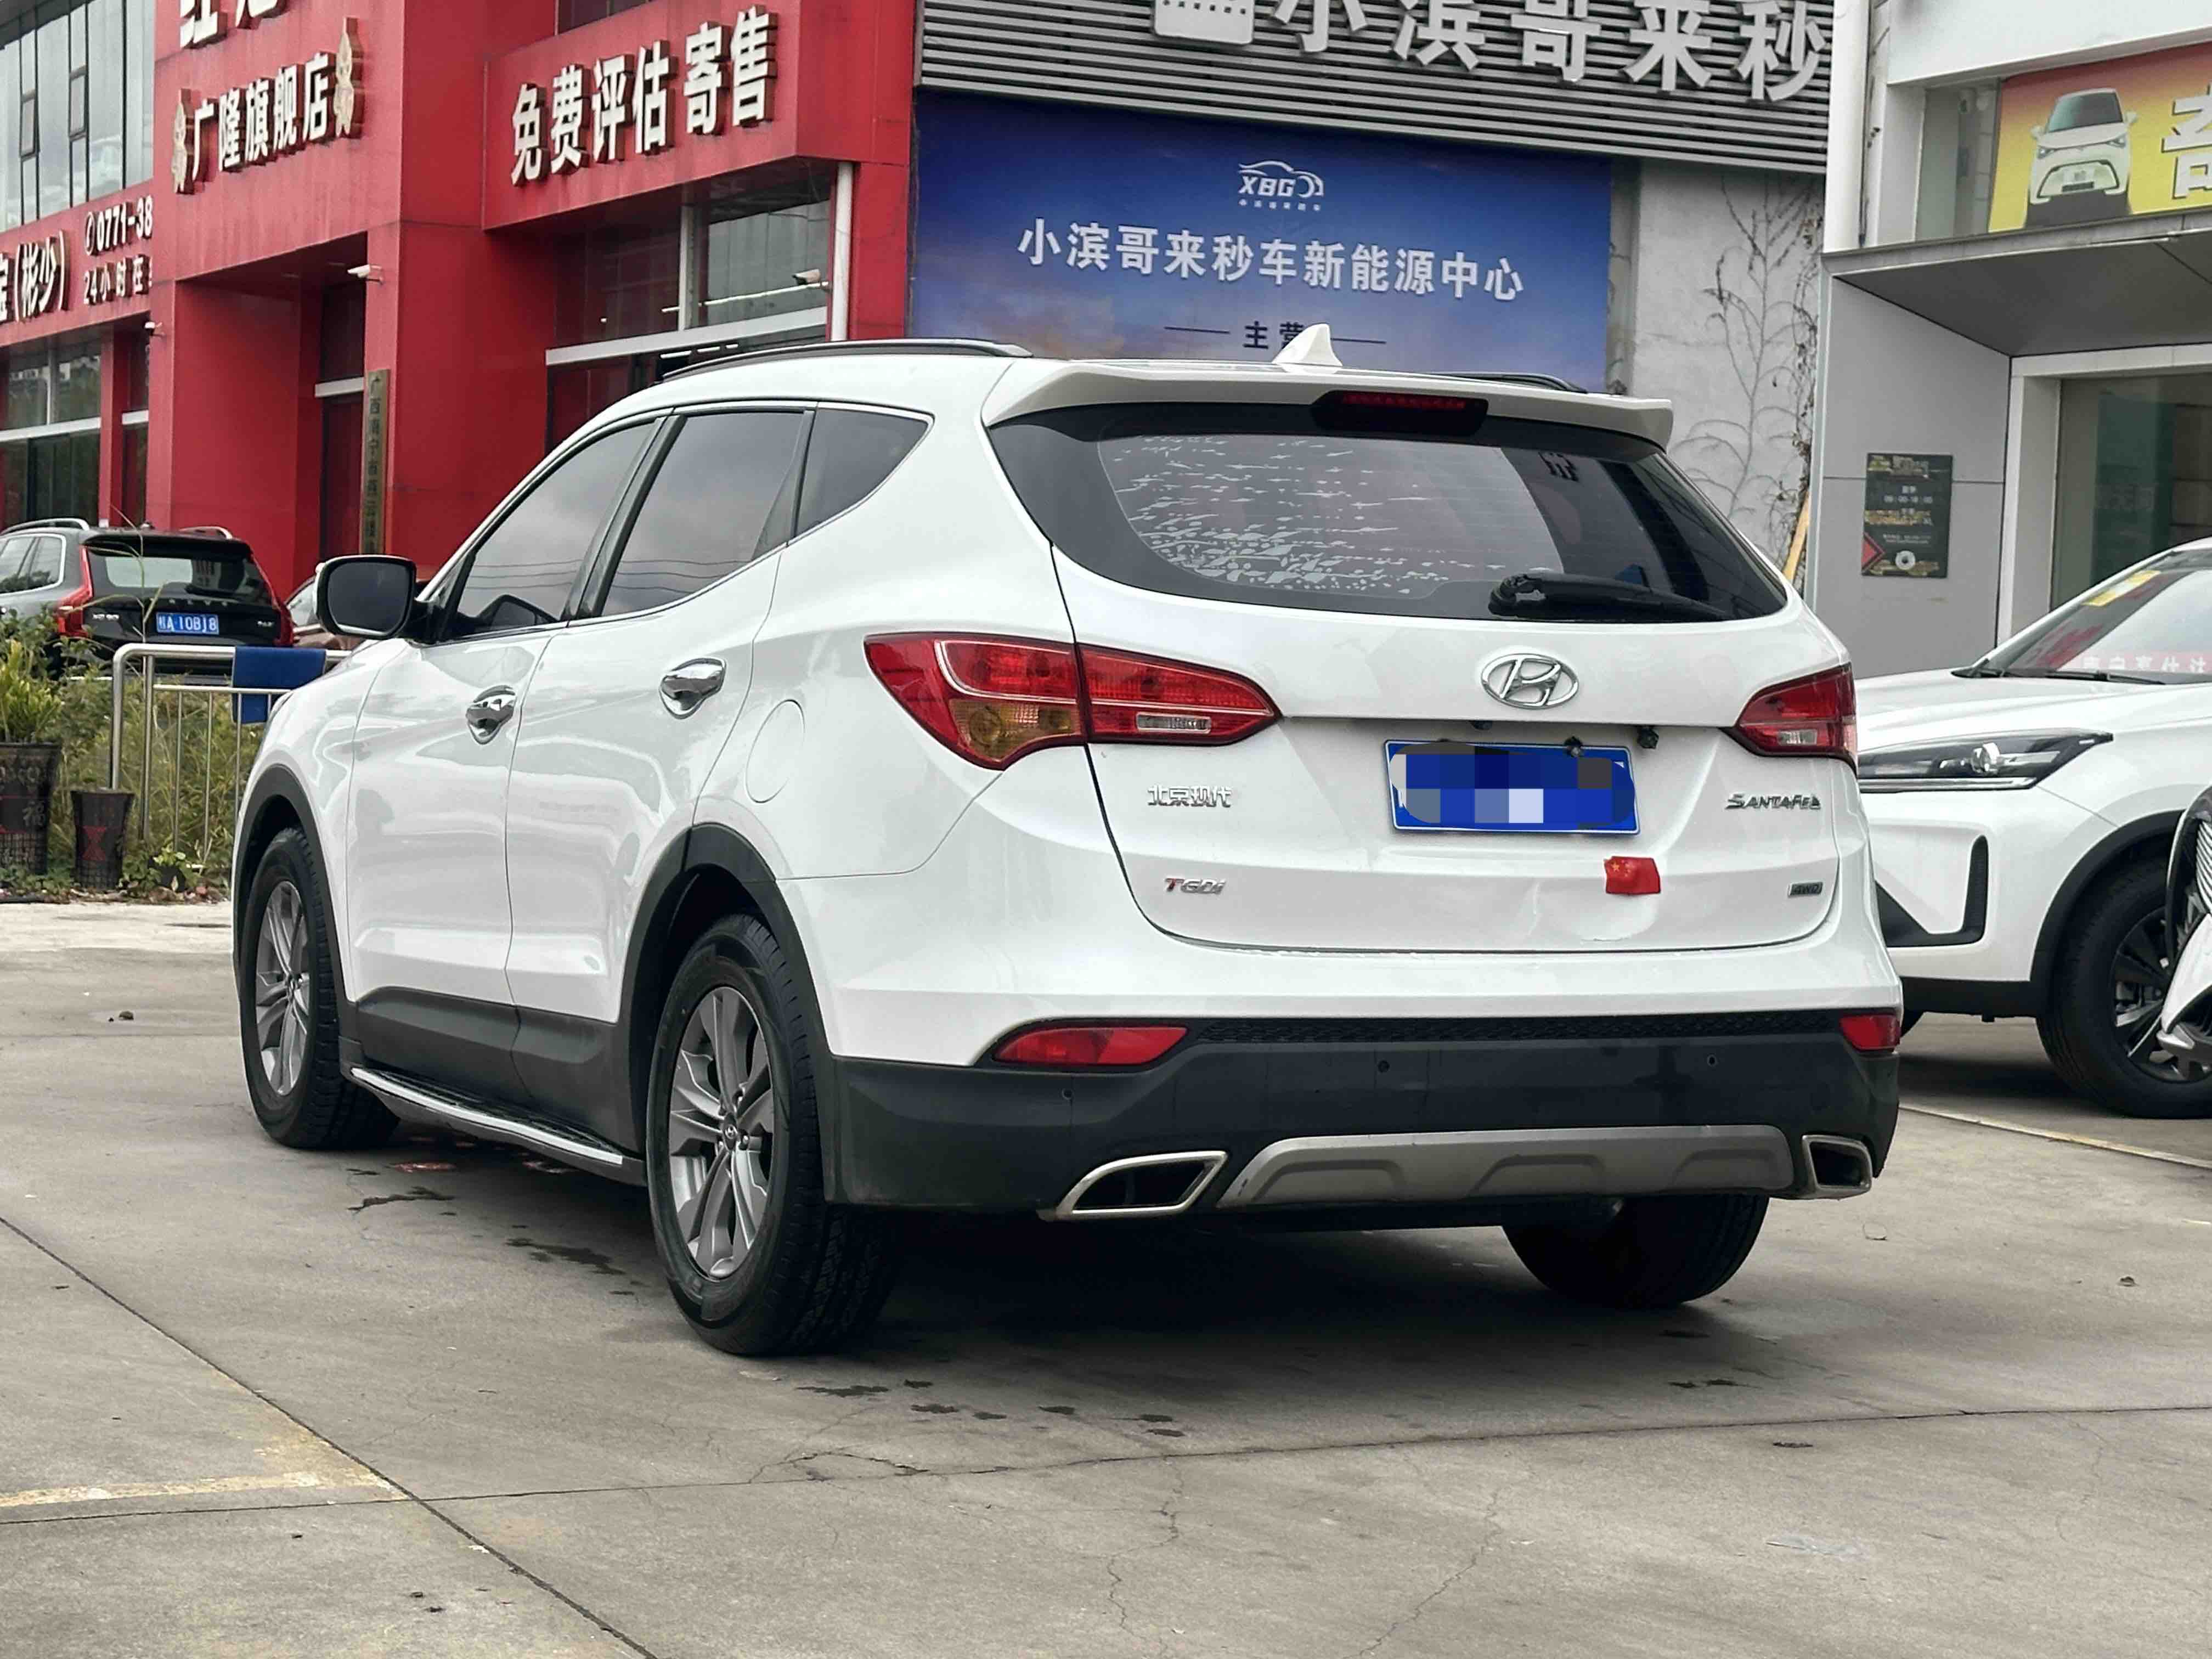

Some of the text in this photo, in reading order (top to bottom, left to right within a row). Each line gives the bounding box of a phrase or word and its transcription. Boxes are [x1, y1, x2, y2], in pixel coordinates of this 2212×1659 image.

[192, 53, 329, 181] 广隆旗舰店
[511, 5, 769, 185] 免费评估 寄售
[1238, 176, 1296, 196] XBG
[1018, 217, 1524, 301] 小滨哥来秒车新能源中心
[1148, 785, 1232, 808] 北京现代
